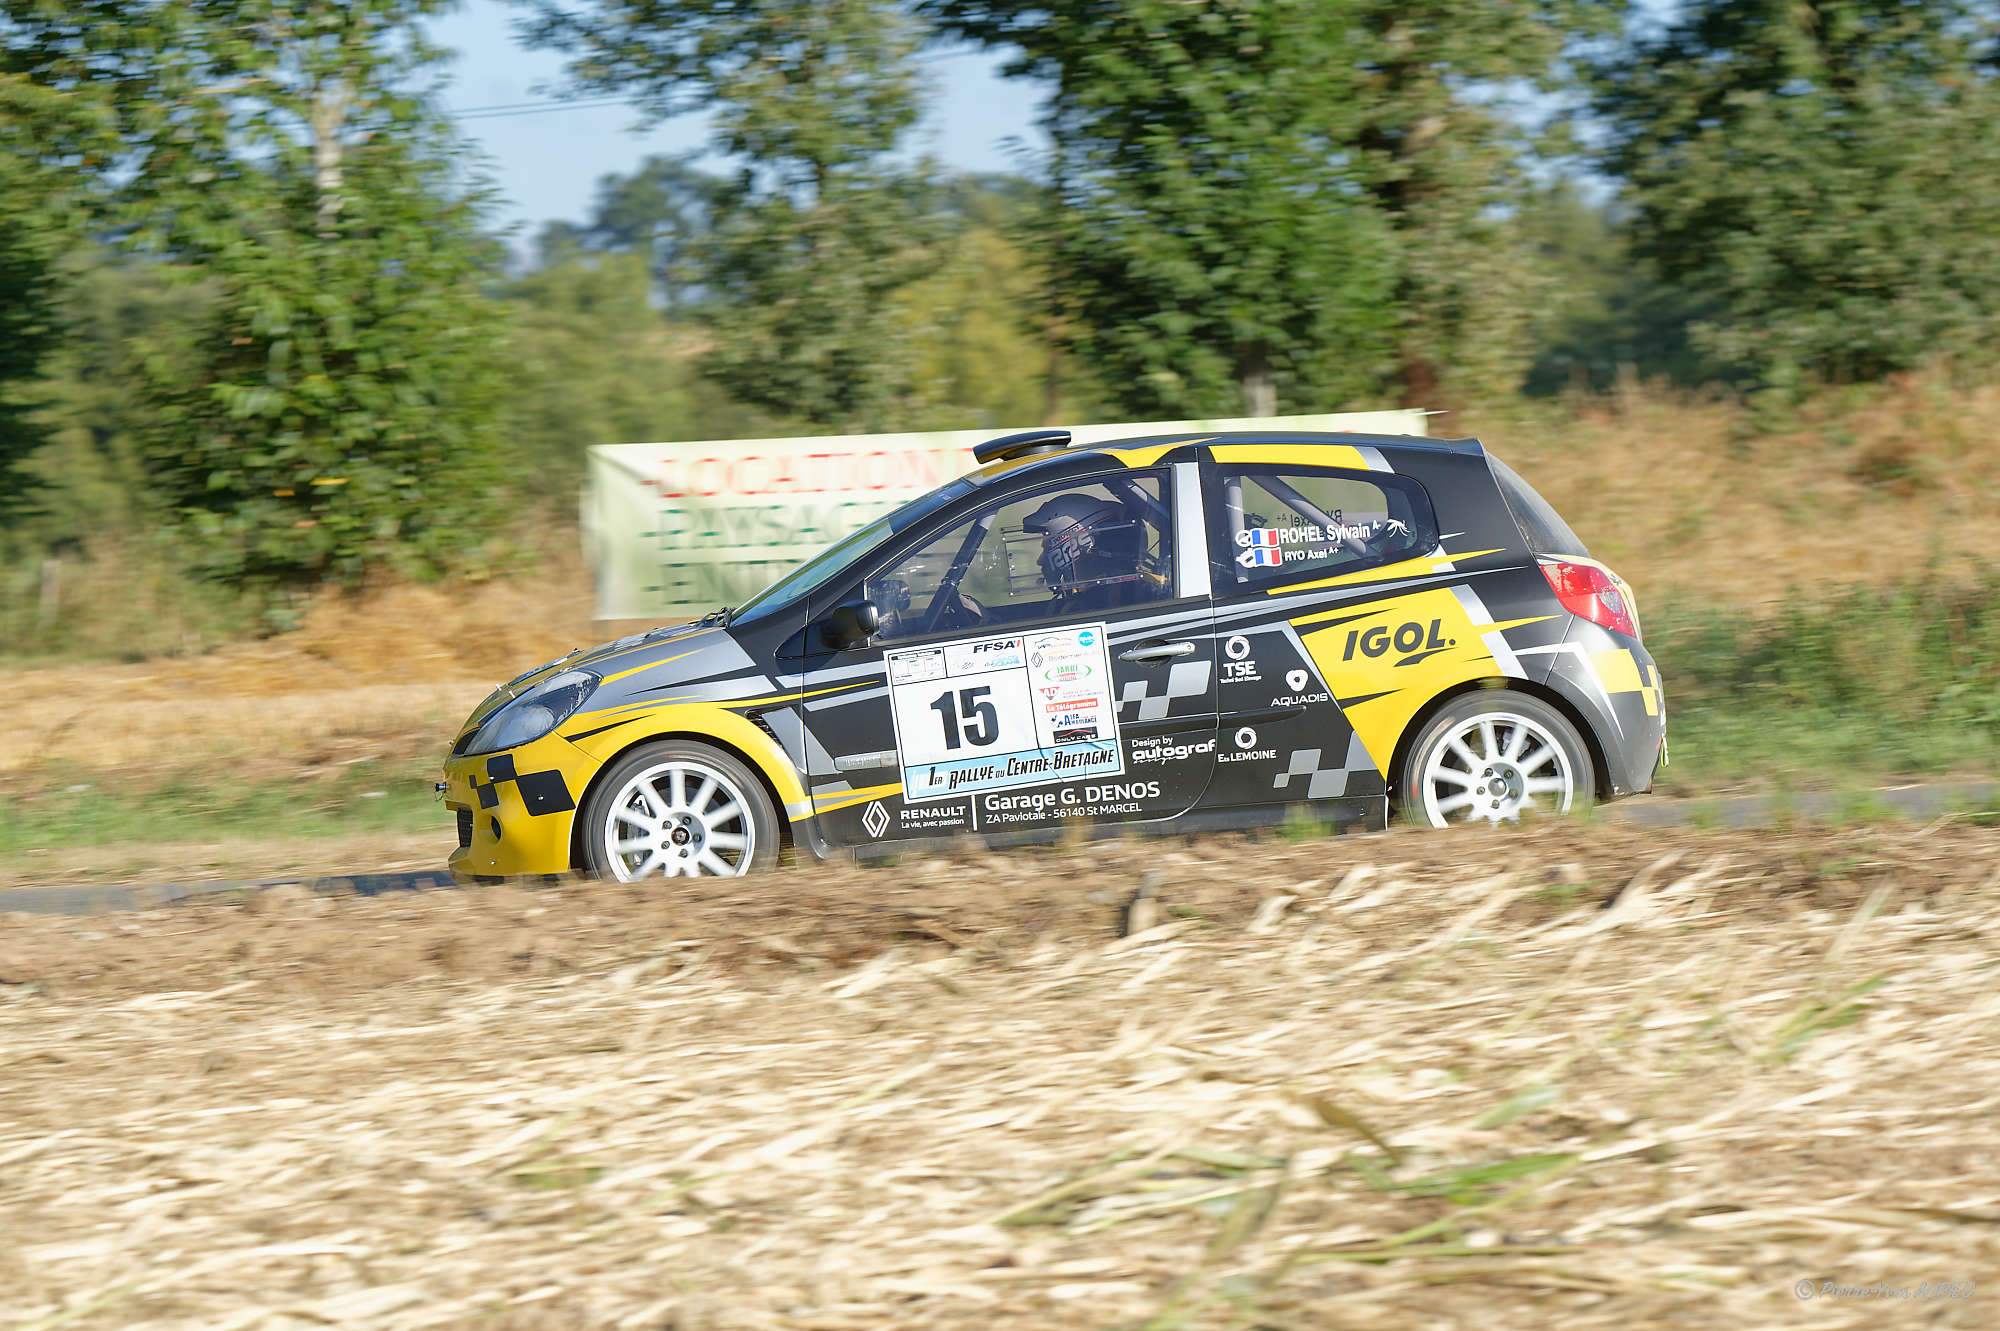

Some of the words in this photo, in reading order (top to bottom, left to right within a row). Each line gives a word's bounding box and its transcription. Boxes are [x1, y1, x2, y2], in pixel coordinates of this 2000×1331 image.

[1280, 527, 1324, 544] ROHEL
[1327, 523, 1371, 543] Sylvain
[1284, 550, 1305, 562] RYO
[1307, 548, 1328, 559] Axel
[973, 640, 1016, 654] FFSA
[1223, 661, 1257, 677] TSE
[1270, 692, 1329, 707] AQUADIS
[930, 686, 1000, 750] 15
[1131, 737, 1160, 748] Design
[1162, 735, 1173, 745] by
[1131, 738, 1216, 760] autograf
[1230, 749, 1277, 762] LEMOINE
[948, 766, 995, 790] RALLYE
[985, 791, 1056, 812] Garage
[1060, 789, 1081, 806] G.
[1085, 781, 1160, 802] DENOS
[900, 805, 966, 820] RENAULT
[985, 814, 1001, 824] ZA
[1002, 810, 1046, 823] Paviotale
[1053, 807, 1086, 819] 56140
[1087, 805, 1099, 817] St
[1100, 801, 1142, 814] MARCEL
[922, 820, 938, 828] avec
[939, 818, 965, 828] passion
